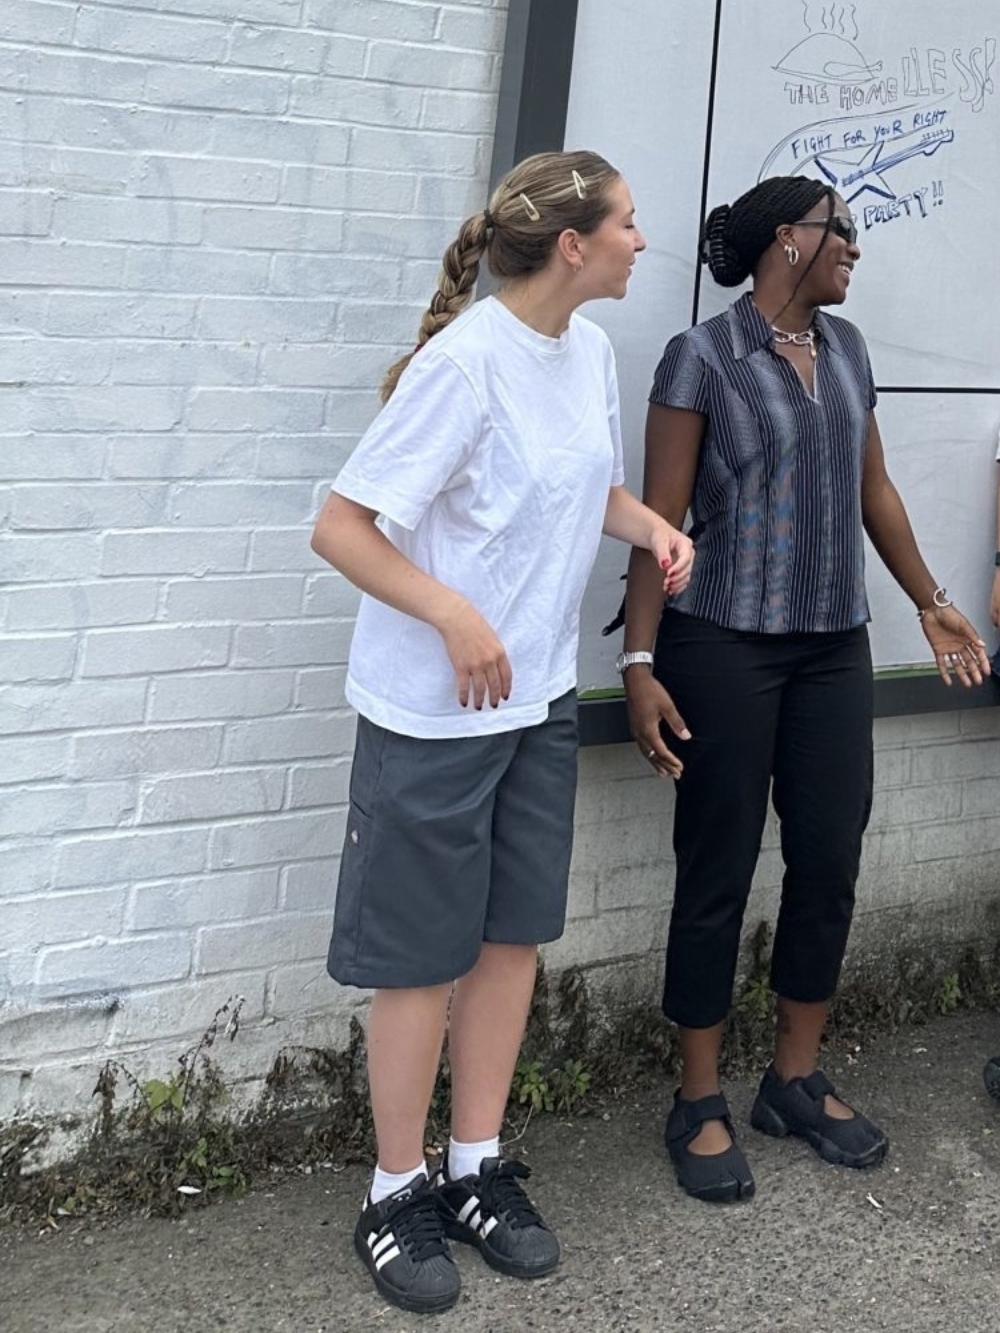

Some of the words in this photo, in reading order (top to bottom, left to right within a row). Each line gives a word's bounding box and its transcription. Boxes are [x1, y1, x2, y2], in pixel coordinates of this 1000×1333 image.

[784, 82, 830, 105] THE
[791, 133, 833, 159] FIGHT
[843, 130, 866, 148] FOR
[874, 120, 903, 142] YOUR
[913, 110, 948, 128] RIGHT
[863, 180, 945, 230] PARTY!!
